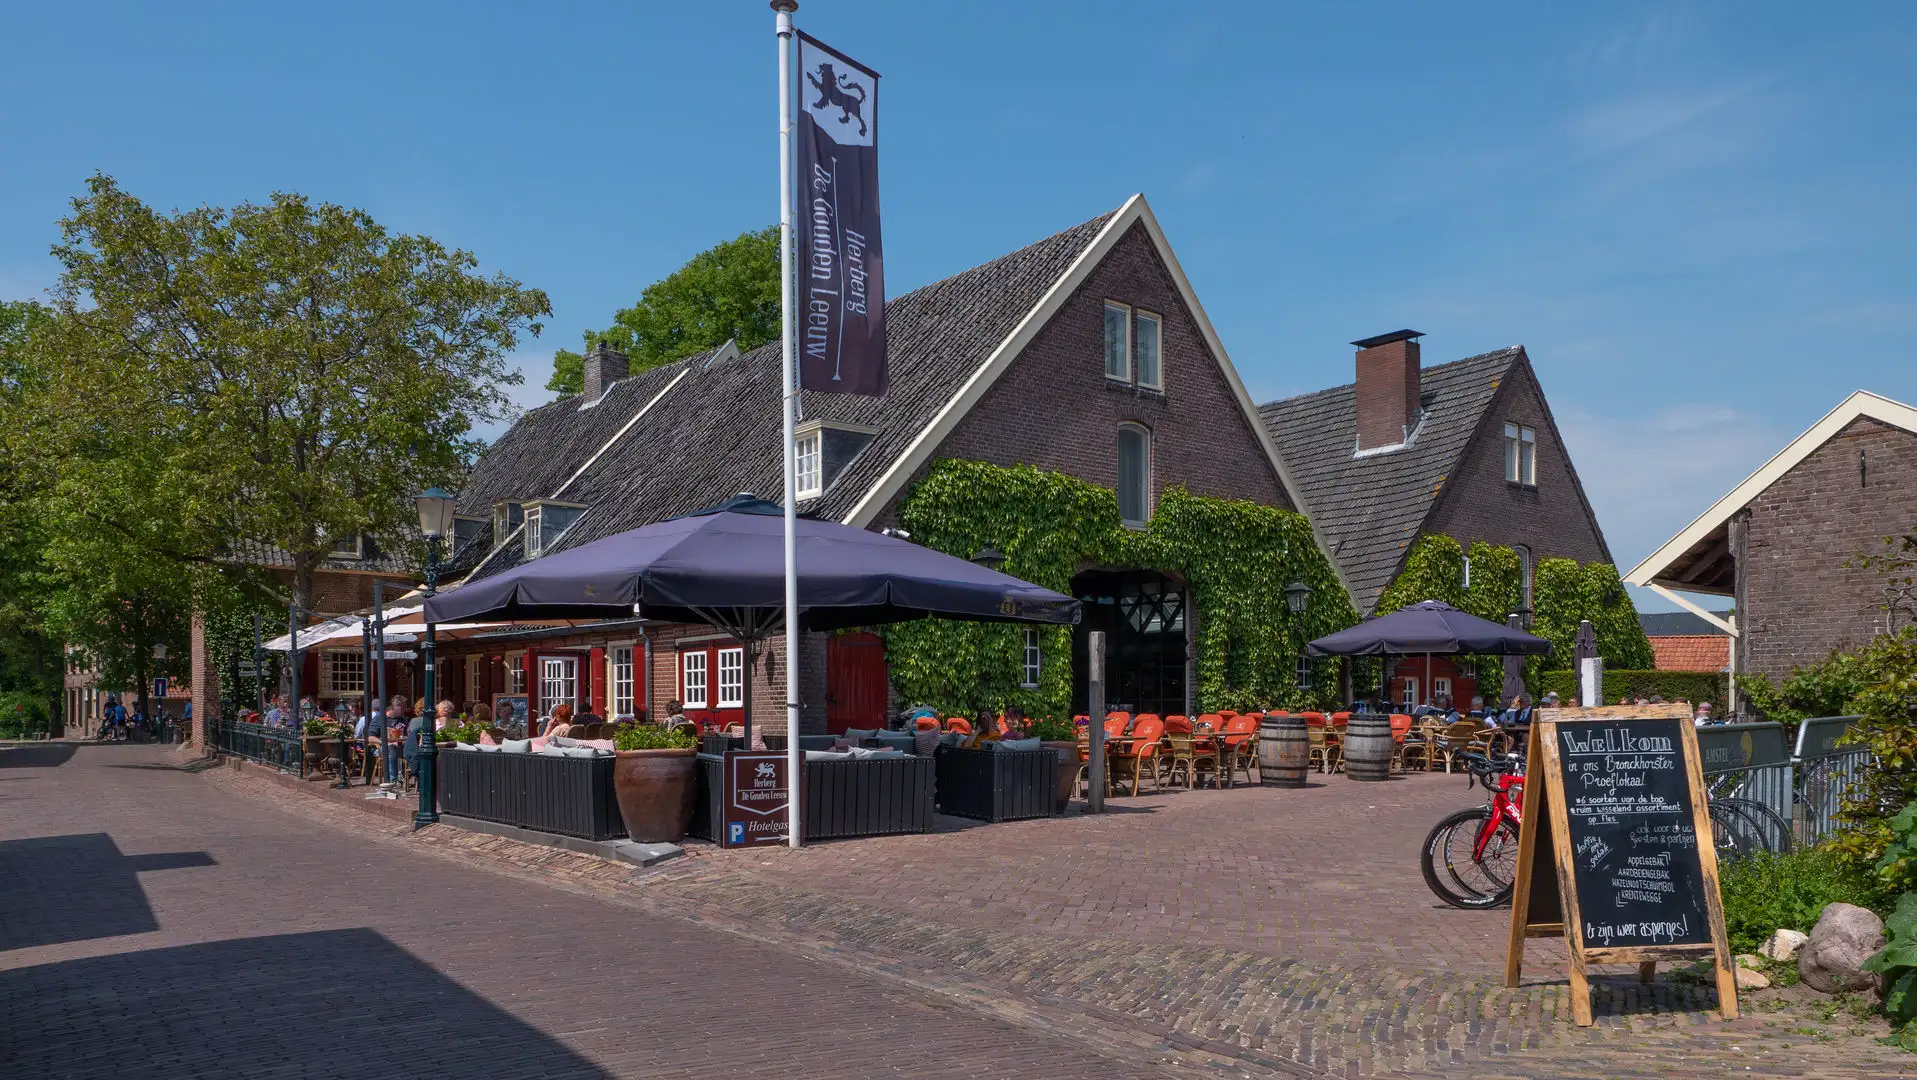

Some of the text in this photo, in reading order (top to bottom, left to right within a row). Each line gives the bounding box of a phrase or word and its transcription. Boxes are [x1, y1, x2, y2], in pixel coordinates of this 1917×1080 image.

[806, 161, 839, 361] De Gouden Leeuw
[846, 227, 868, 317] Herberg
[1705, 747, 1729, 763] AMSTEL
[1568, 754, 1675, 773] in ons Bronckhorster
[754, 779, 776, 788] Herberg
[1580, 771, 1647, 796] Proeflokaal
[742, 790, 788, 801] De Gouden Leeuw
[1589, 793, 1617, 803] soorten
[1638, 794, 1648, 803] de
[1576, 801, 1681, 814] ruim wisselend assortiment
[731, 825, 743, 842] P
[1627, 856, 1665, 867] APPELGEBAK
[1597, 922, 1615, 946] zijn
[1617, 923, 1637, 937] weer
[1640, 913, 1689, 943] asperges!
